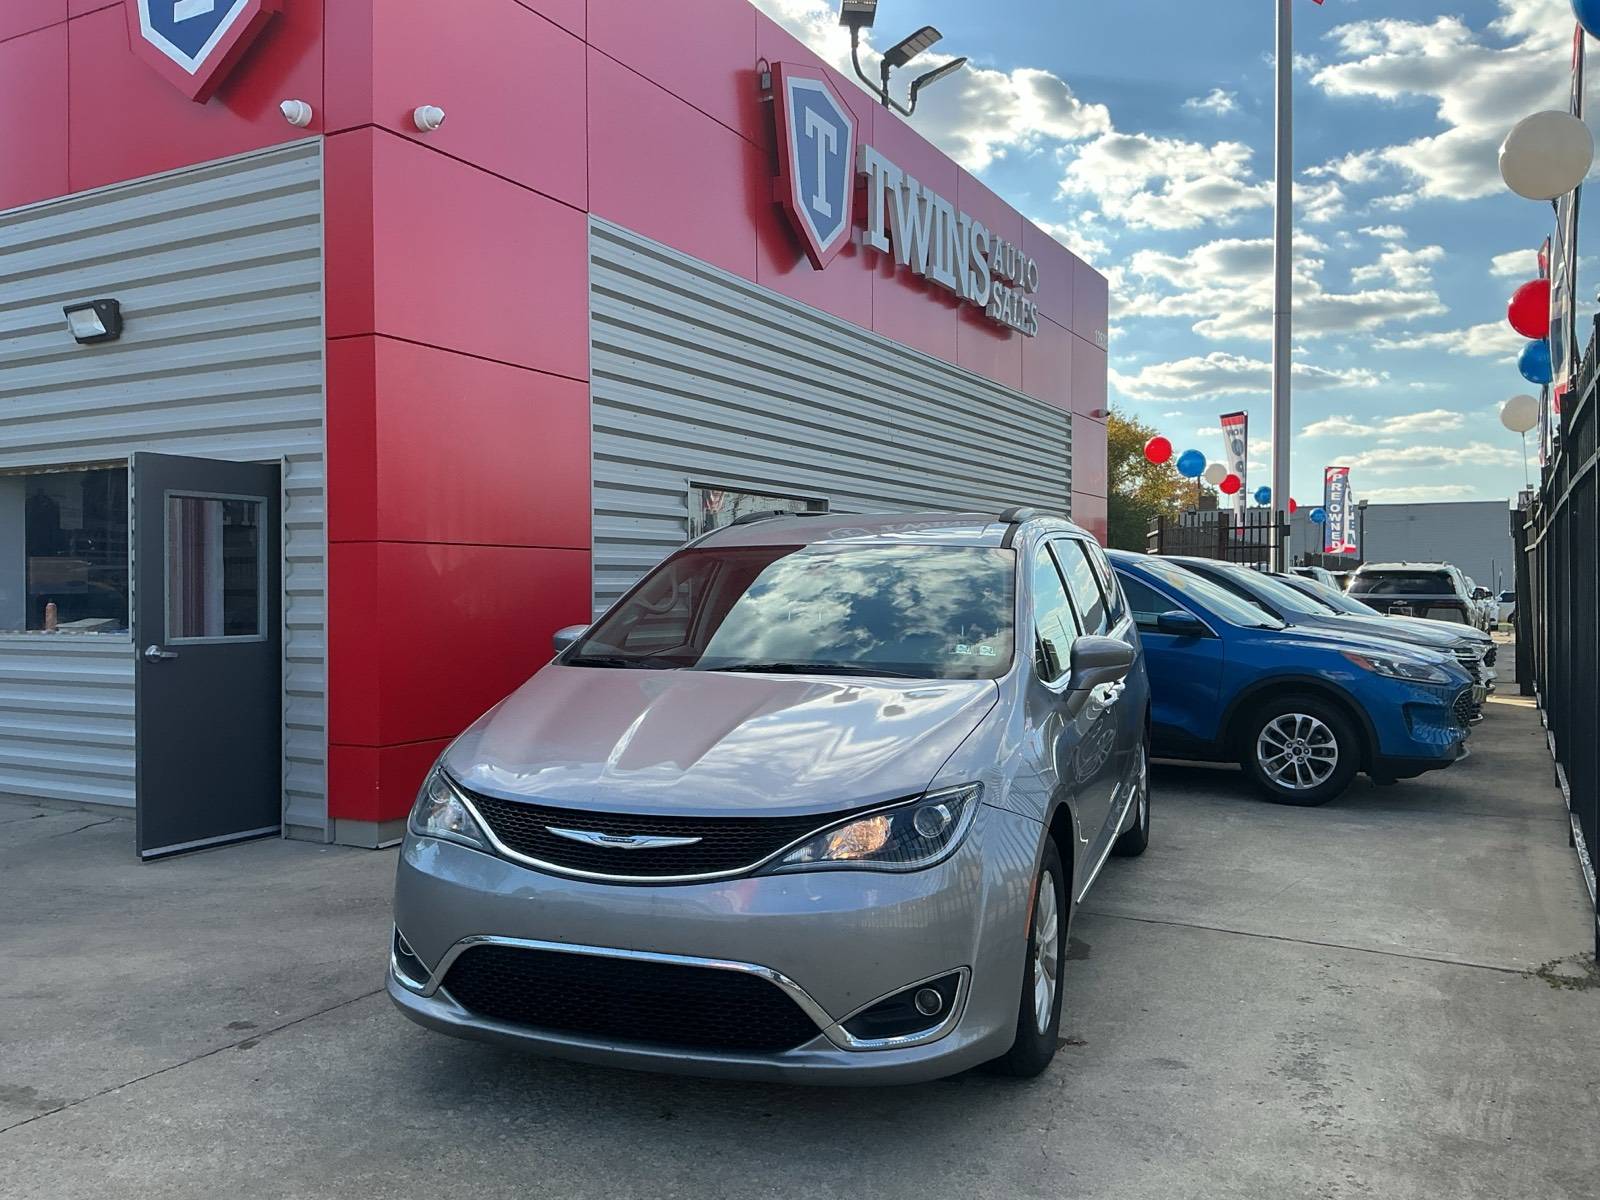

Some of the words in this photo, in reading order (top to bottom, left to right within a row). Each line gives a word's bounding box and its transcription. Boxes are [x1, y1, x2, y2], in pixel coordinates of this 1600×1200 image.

[804, 105, 838, 219] T
[858, 143, 990, 307] TWINS
[991, 234, 1039, 294] AUTO
[990, 280, 1039, 337] SALES
